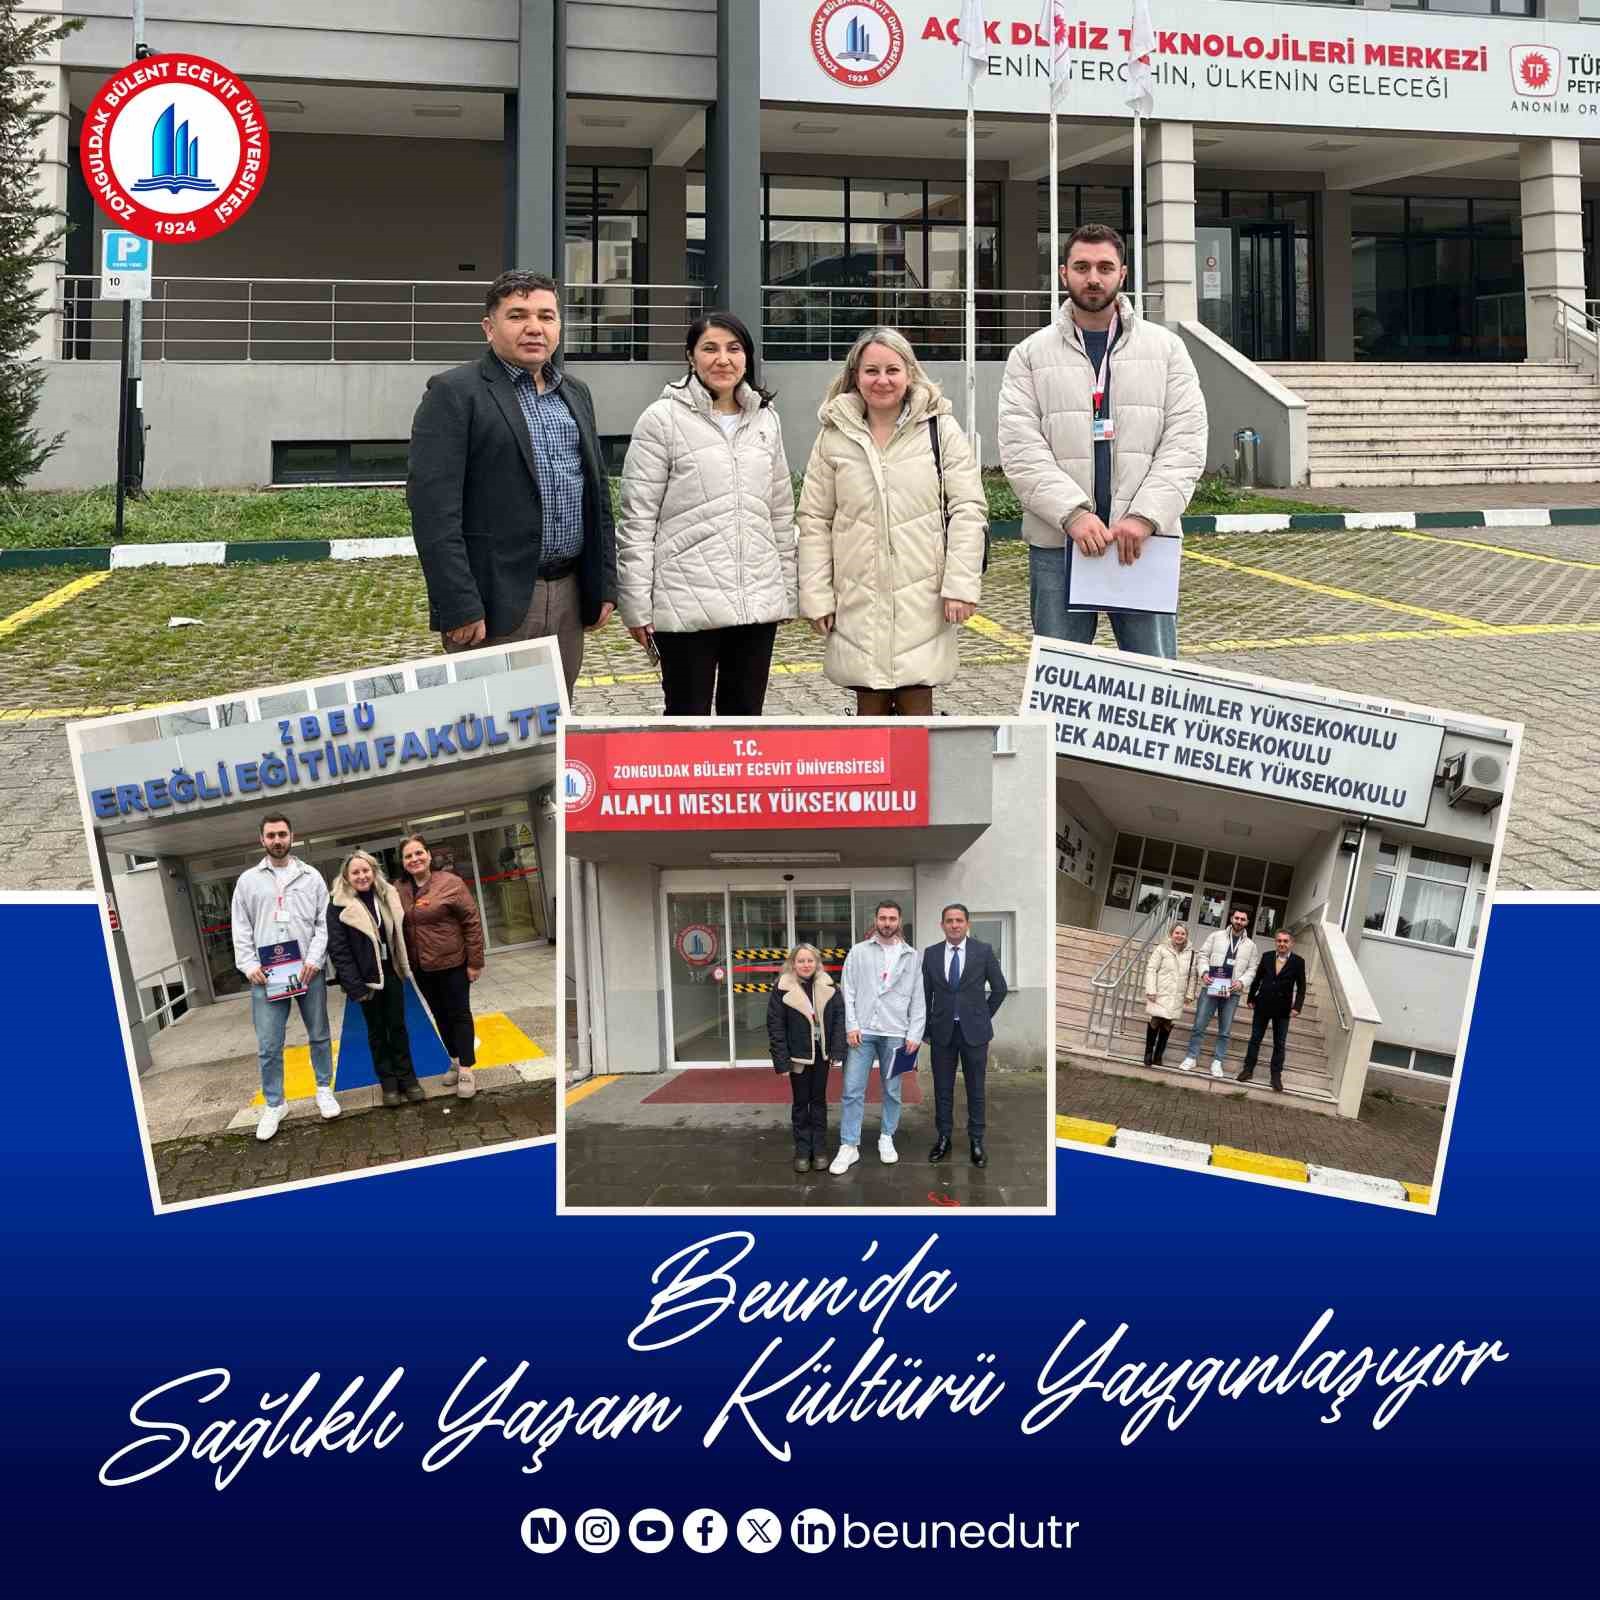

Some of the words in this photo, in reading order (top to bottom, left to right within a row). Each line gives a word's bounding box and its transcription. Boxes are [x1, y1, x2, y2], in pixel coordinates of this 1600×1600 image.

[921, 16, 1001, 46] AÇK
[1118, 28, 1355, 65] TKNOLOJİLERİ
[1365, 43, 1488, 72] MERKEZİ
[1206, 64, 1318, 92] ÜLKENİN
[1328, 74, 1448, 98] GELECEĞİ
[1510, 101, 1569, 113] ANONİM
[118, 237, 141, 262] P
[109, 277, 121, 287] 10
[1151, 684, 1243, 721] BİLİMLER
[1250, 704, 1398, 750] YÜKSEKOKULU
[733, 739, 763, 757] T.C.
[1097, 703, 1178, 736] MESLEK
[1184, 719, 1332, 766] YÜKSEKOKULU
[91, 760, 232, 818] EREĞLİ
[235, 739, 370, 793] EĞİTİM
[614, 765, 690, 779] ZONGULDAK
[694, 761, 743, 778] BÜLENT
[747, 759, 792, 776] ECEVİT
[797, 757, 885, 776] ÜNİVERSİTESİ
[1092, 730, 1170, 761] ADALET
[1174, 746, 1254, 779] MESLEK
[1260, 761, 1407, 808] YÜKSEKOKULU
[600, 793, 672, 816] ALAPLI
[679, 791, 762, 816] MESLEK
[768, 787, 918, 814] YÜKSEKOKULU
